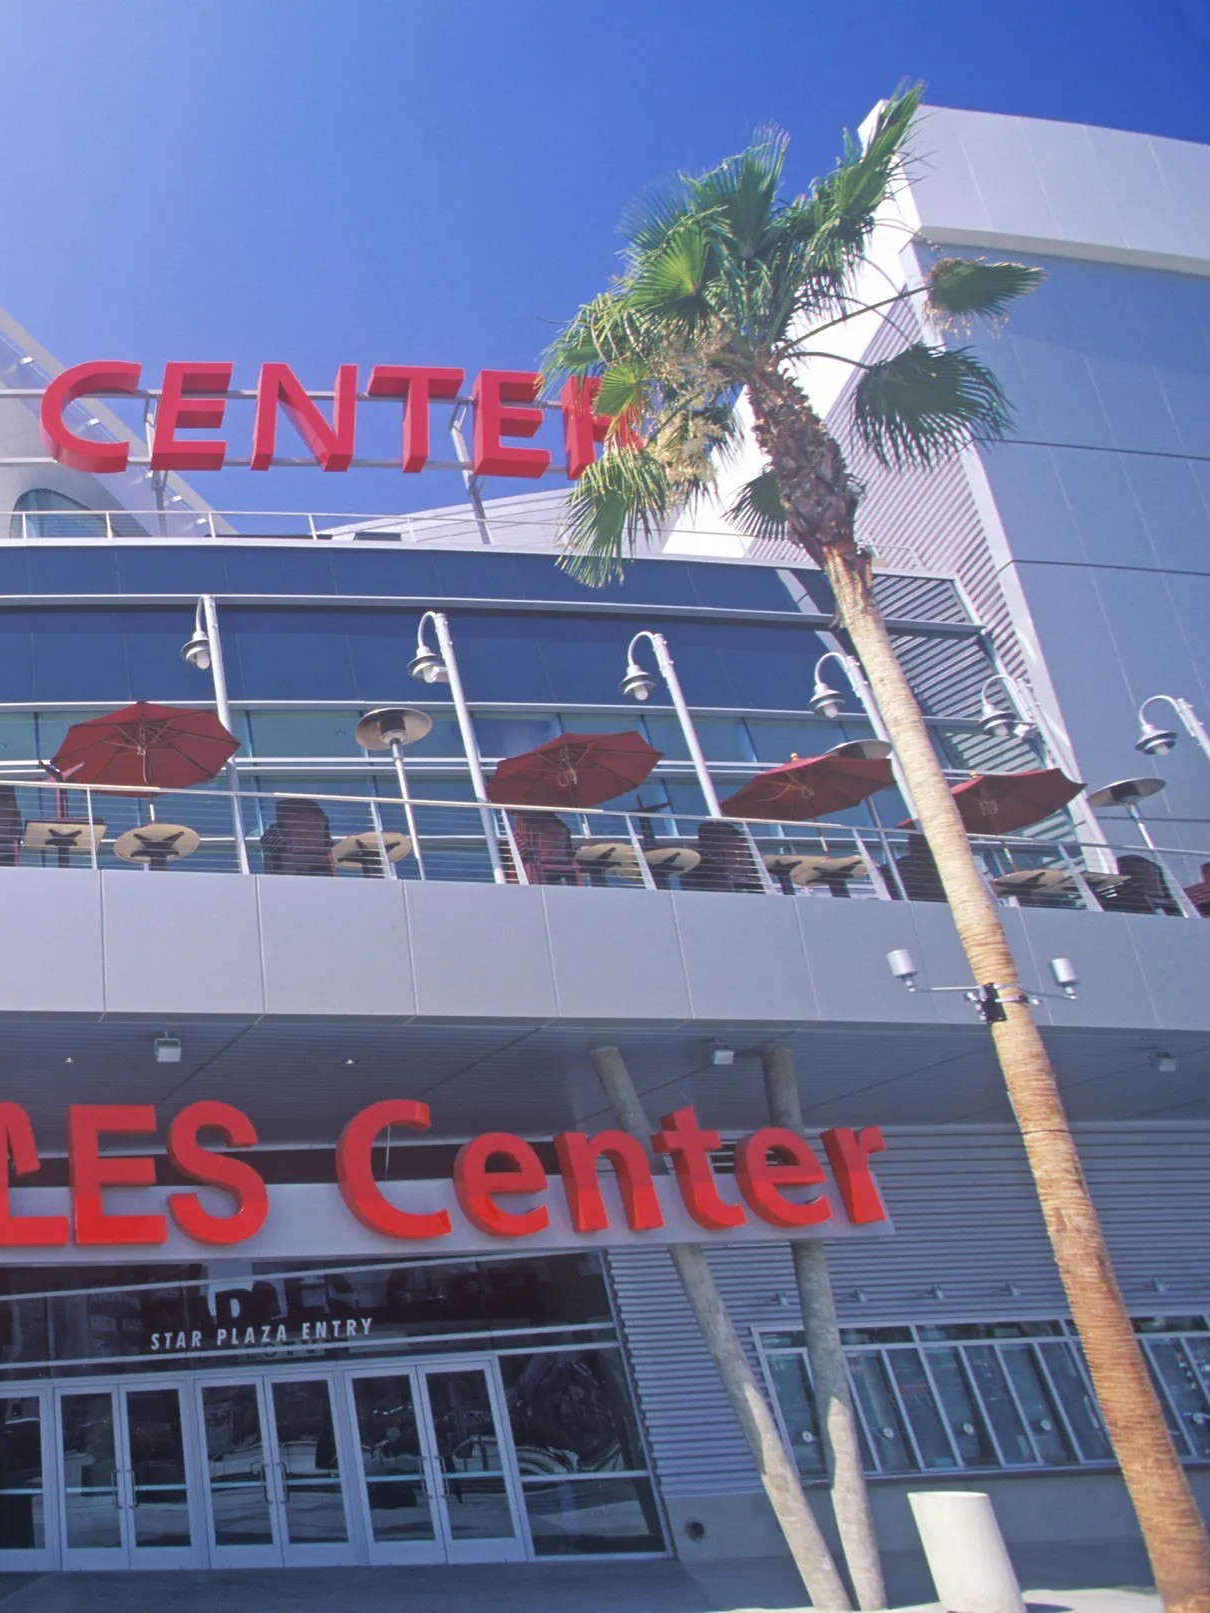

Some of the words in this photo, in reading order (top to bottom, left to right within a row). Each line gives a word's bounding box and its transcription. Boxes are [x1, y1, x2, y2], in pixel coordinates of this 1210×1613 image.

[336, 1098, 886, 1239] Center
[150, 1330, 202, 1350] STAR
[216, 1324, 287, 1346] PLAZA
[302, 1317, 373, 1340] ENTRY
